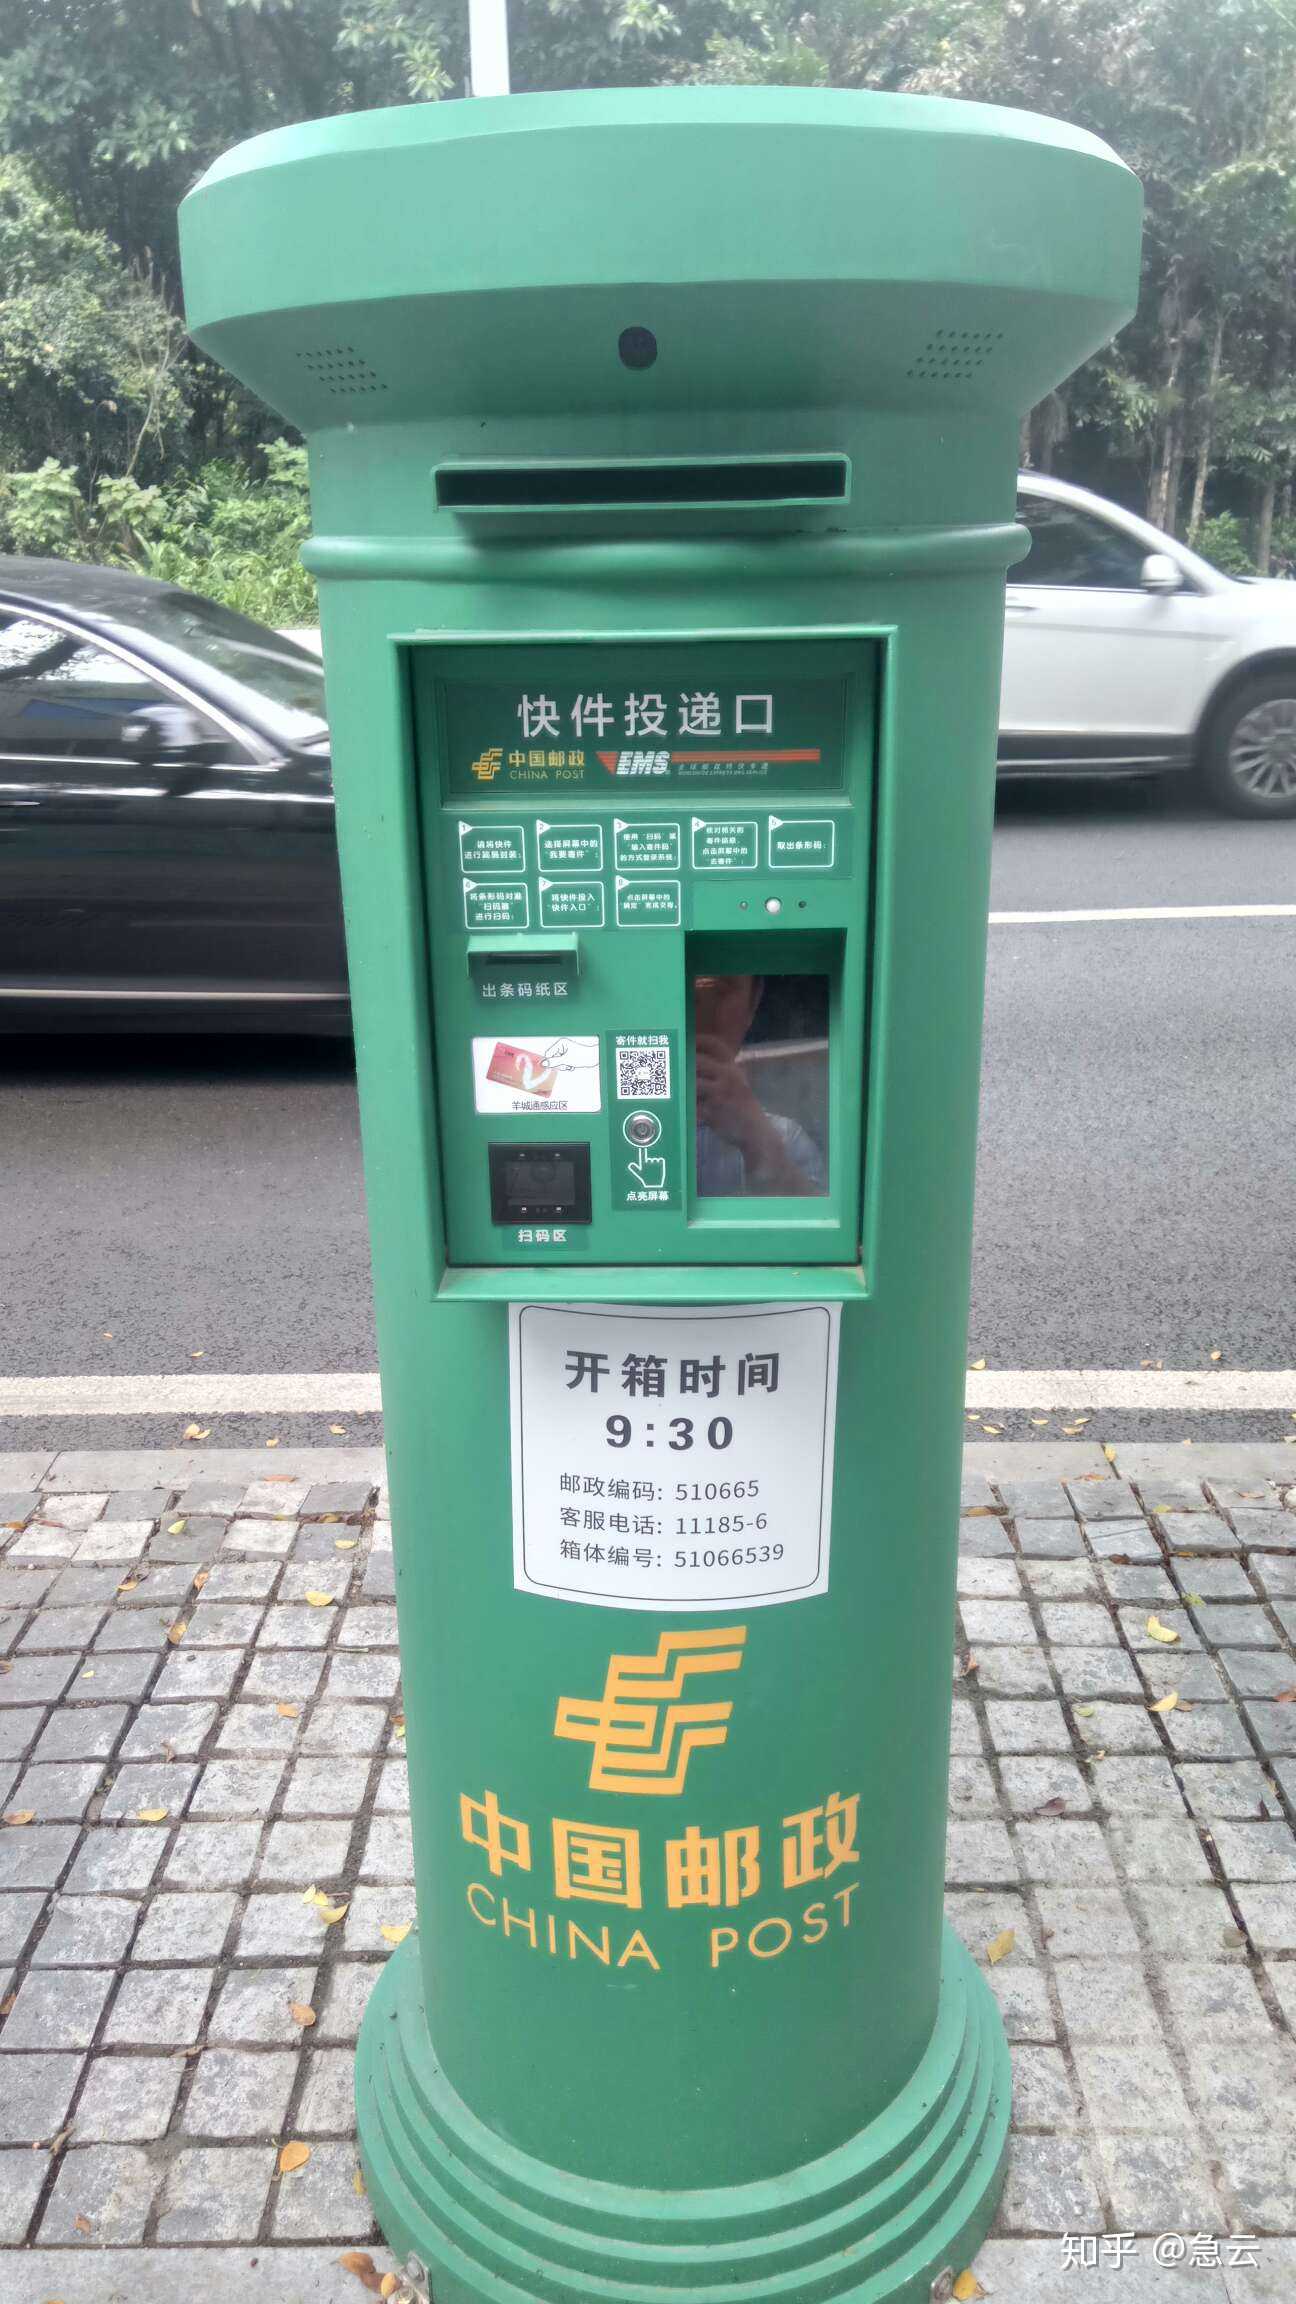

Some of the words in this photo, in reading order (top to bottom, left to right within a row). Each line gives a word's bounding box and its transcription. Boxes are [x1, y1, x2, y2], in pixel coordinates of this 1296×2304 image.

[517, 692, 773, 738] 快件投递口
[508, 749, 585, 768] 中国邮政
[616, 750, 672, 775] EMS
[510, 769, 548, 780] CHINA
[555, 769, 585, 779] POST
[483, 981, 569, 998] 出条码纸区
[616, 1035, 670, 1046] 寄件就扫我
[627, 1190, 669, 1202] 点亮屏幕
[518, 1229, 567, 1243] 扫码区
[564, 1349, 781, 1399] 开箱时间
[605, 1414, 734, 1451] 9:30
[460, 1789, 861, 1909] 中国邮政
[466, 1882, 661, 1970] CHINA
[710, 1882, 860, 1968] POST
